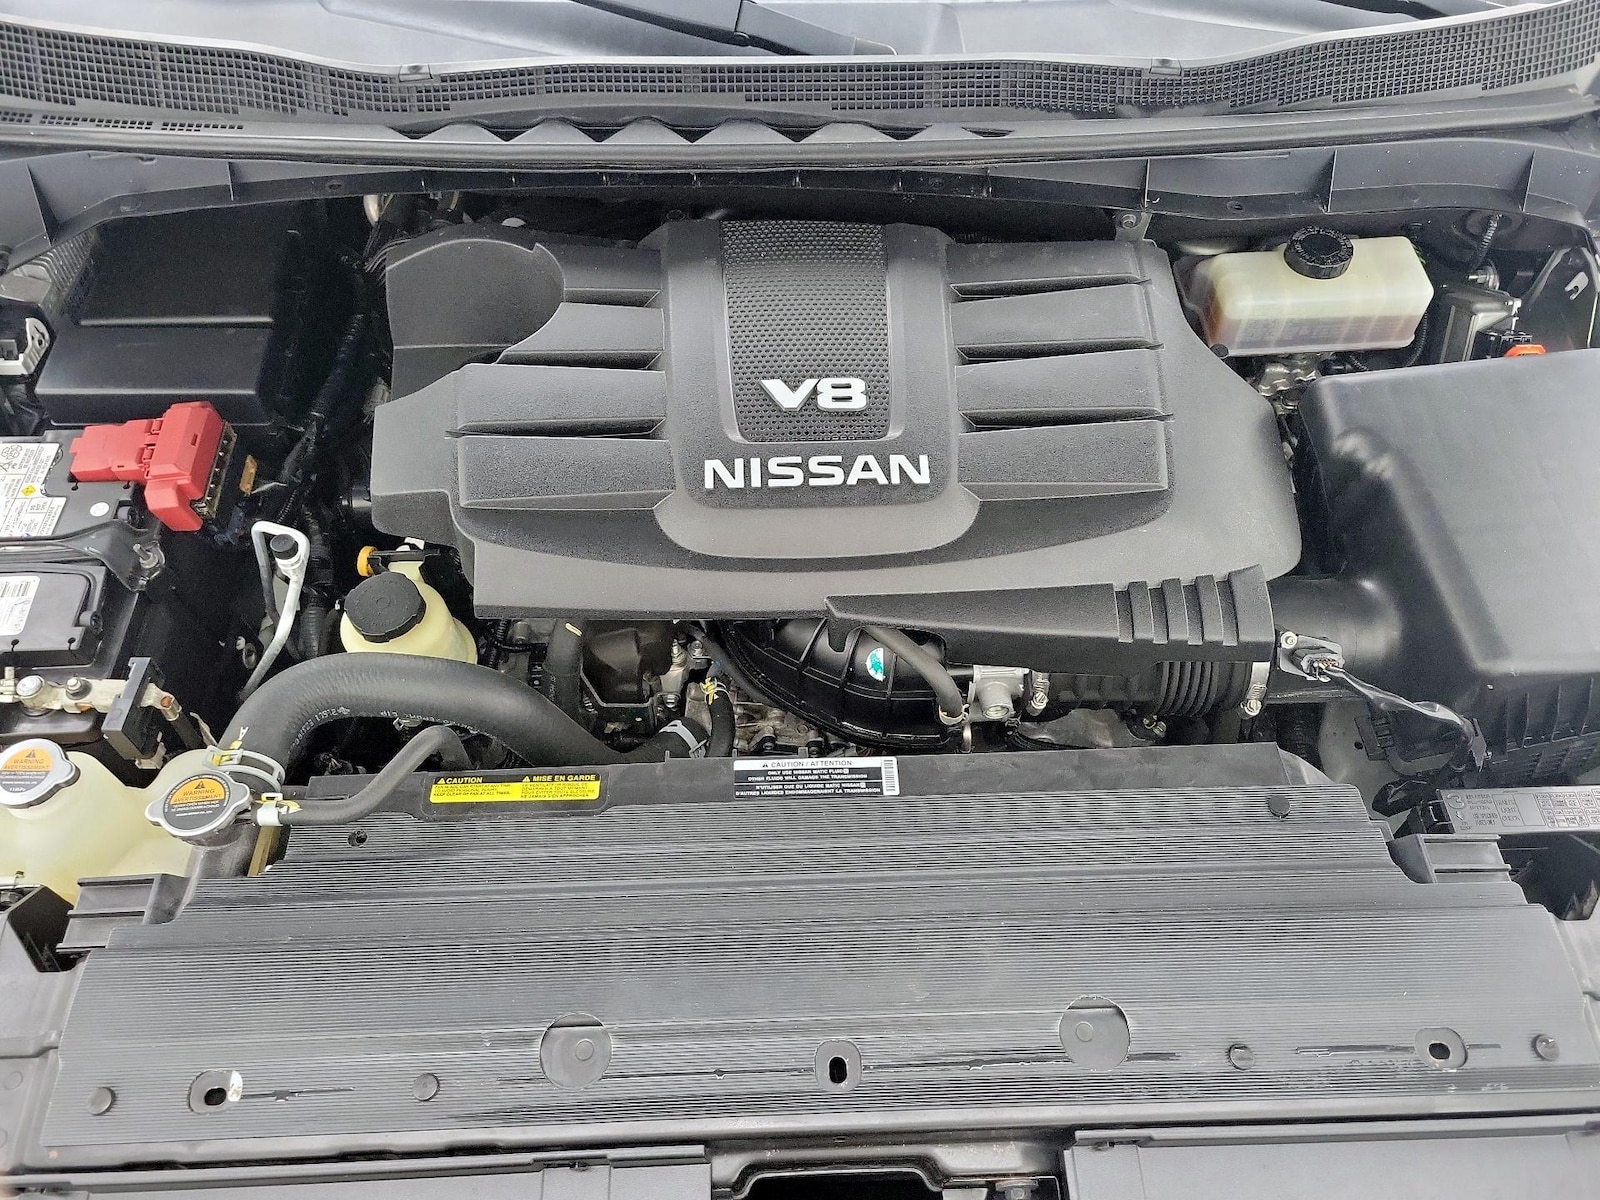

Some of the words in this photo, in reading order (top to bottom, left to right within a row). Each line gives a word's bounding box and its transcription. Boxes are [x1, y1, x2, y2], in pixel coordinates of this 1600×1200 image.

[760, 377, 868, 412] V8
[704, 454, 931, 489] NISSAN
[174, 794, 221, 802] AVERTISSEMENT
